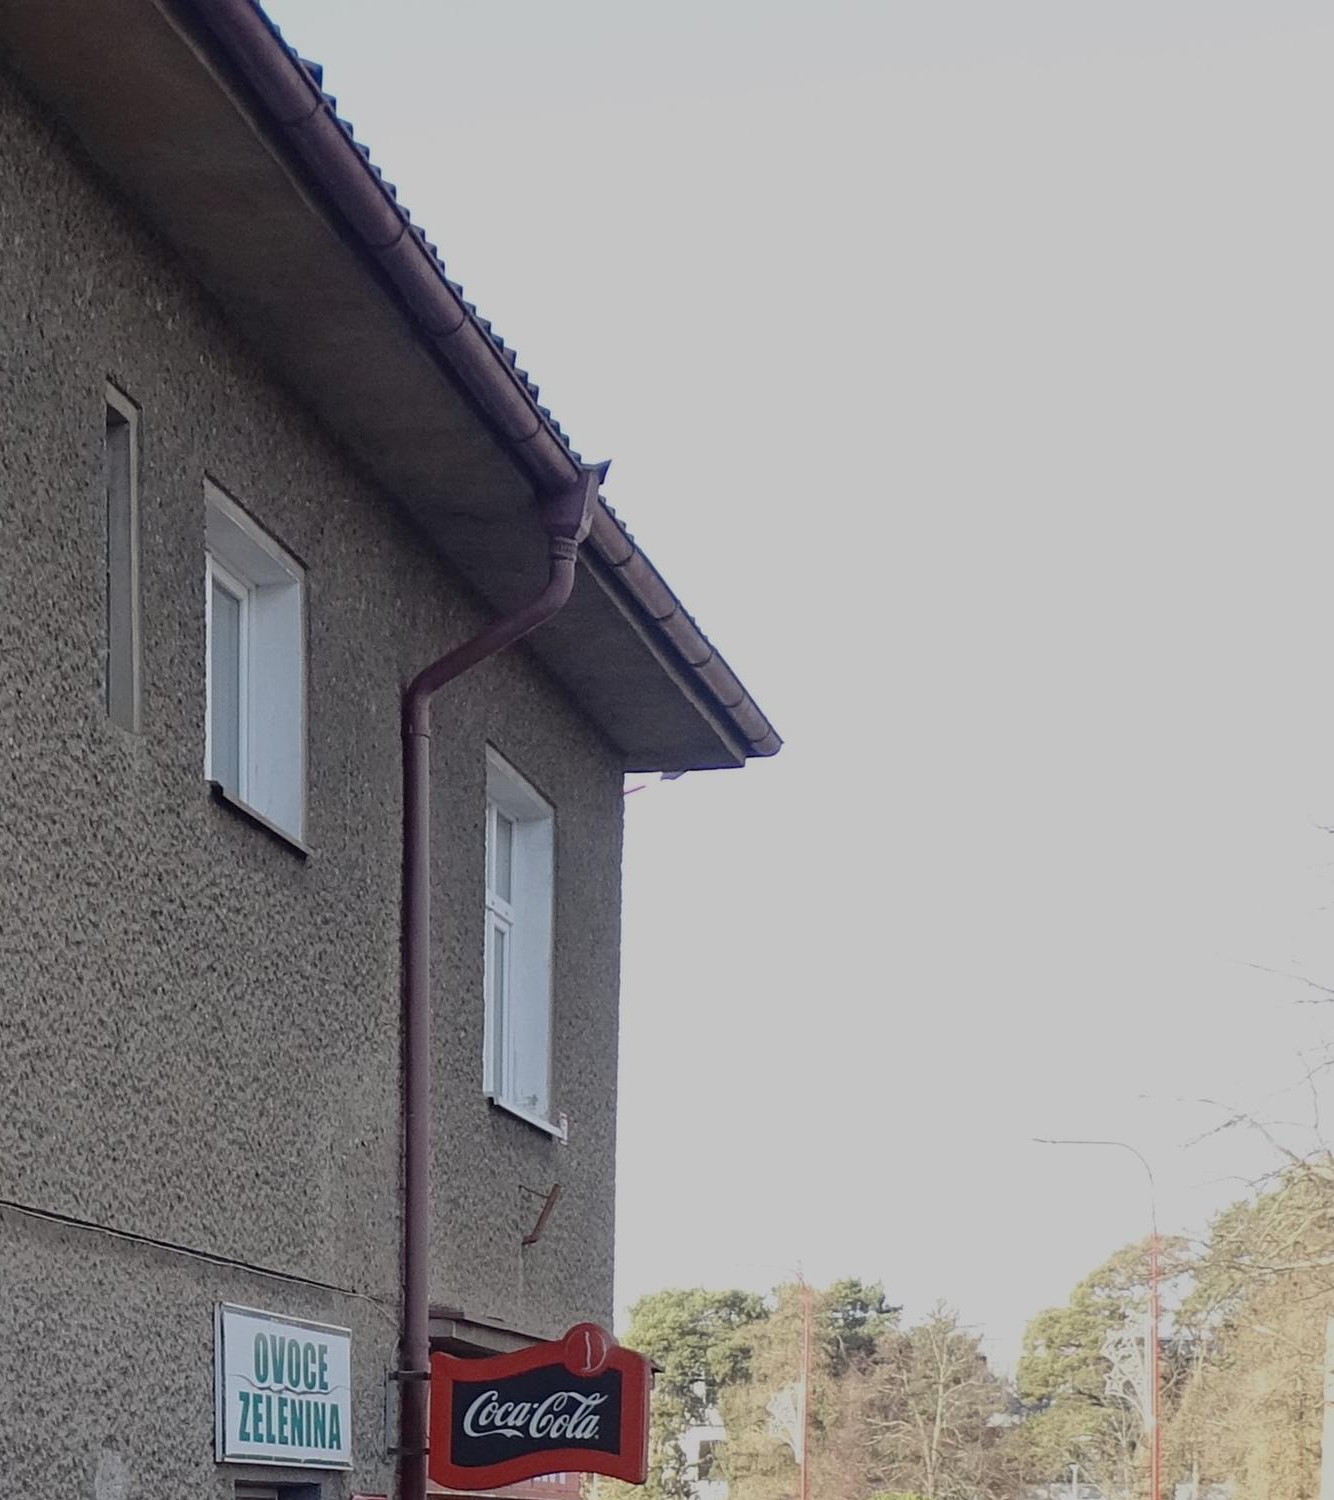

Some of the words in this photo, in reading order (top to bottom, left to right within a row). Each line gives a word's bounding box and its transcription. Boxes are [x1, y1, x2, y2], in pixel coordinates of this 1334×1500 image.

[254, 1332, 329, 1391] OVOCE
[238, 1391, 342, 1451] ZELENINA
[463, 1390, 609, 1440] Coca-Cola
